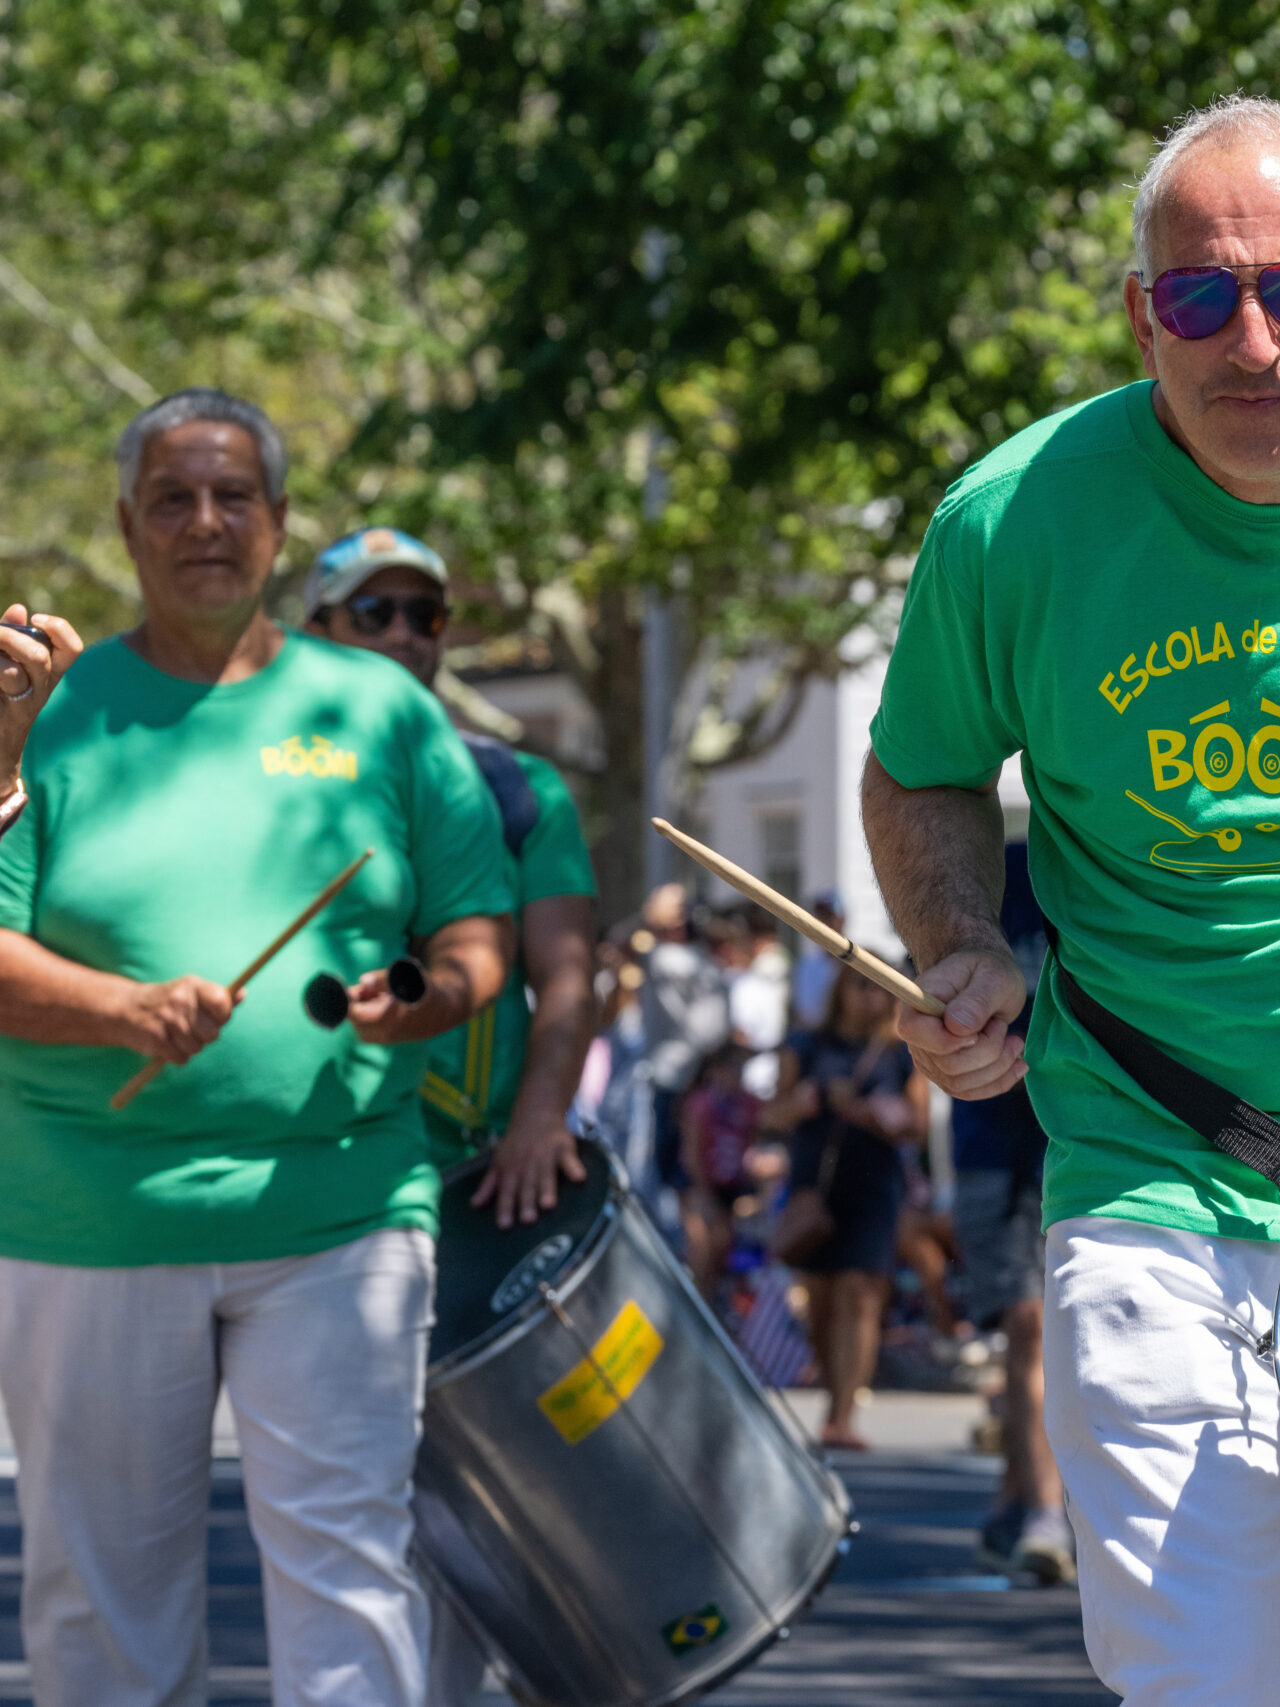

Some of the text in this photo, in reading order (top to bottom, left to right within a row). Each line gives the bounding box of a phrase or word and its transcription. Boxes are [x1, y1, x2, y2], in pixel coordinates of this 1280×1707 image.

[1099, 622, 1236, 714] ESCOLA
[1241, 619, 1278, 654] de
[260, 746, 357, 781] BOOM
